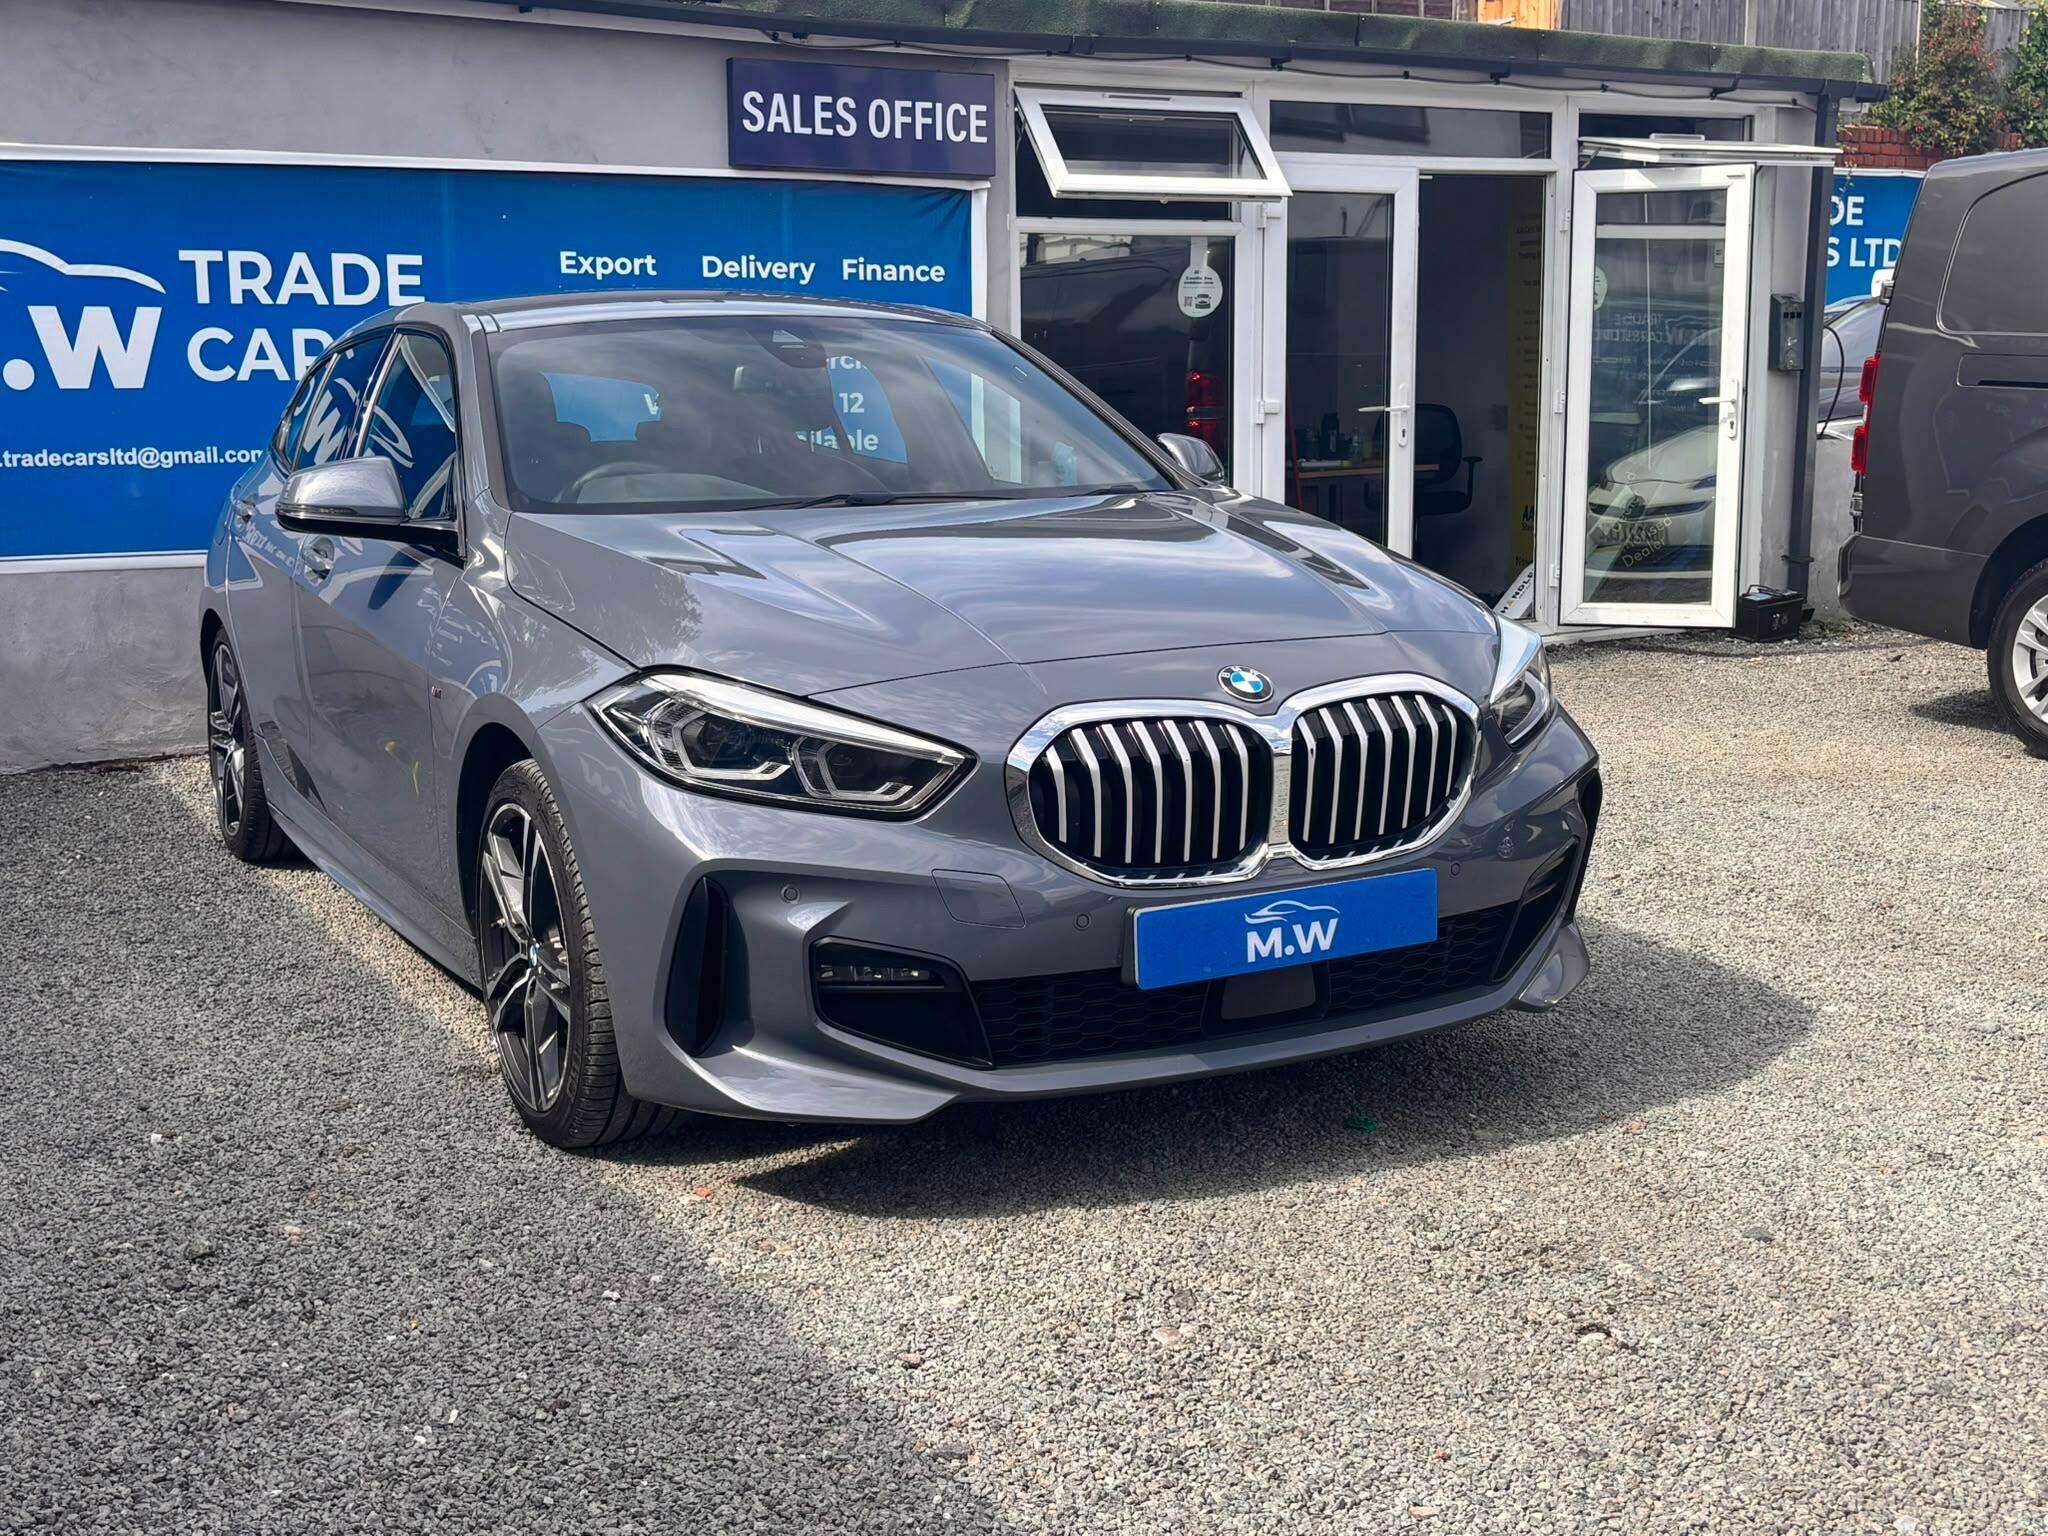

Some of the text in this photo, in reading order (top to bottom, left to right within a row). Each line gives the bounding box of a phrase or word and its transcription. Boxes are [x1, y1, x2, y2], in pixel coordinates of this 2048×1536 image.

[742, 90, 988, 143] SALES OFFICE
[559, 250, 657, 280] Export
[1849, 237, 1902, 267] LTD
[178, 249, 426, 307] TRADE
[701, 254, 816, 286] Delivery
[842, 256, 946, 282] Finance
[838, 392, 865, 414] 12
[1622, 537, 1667, 567] Dealer
[1246, 917, 1339, 963] M.W
